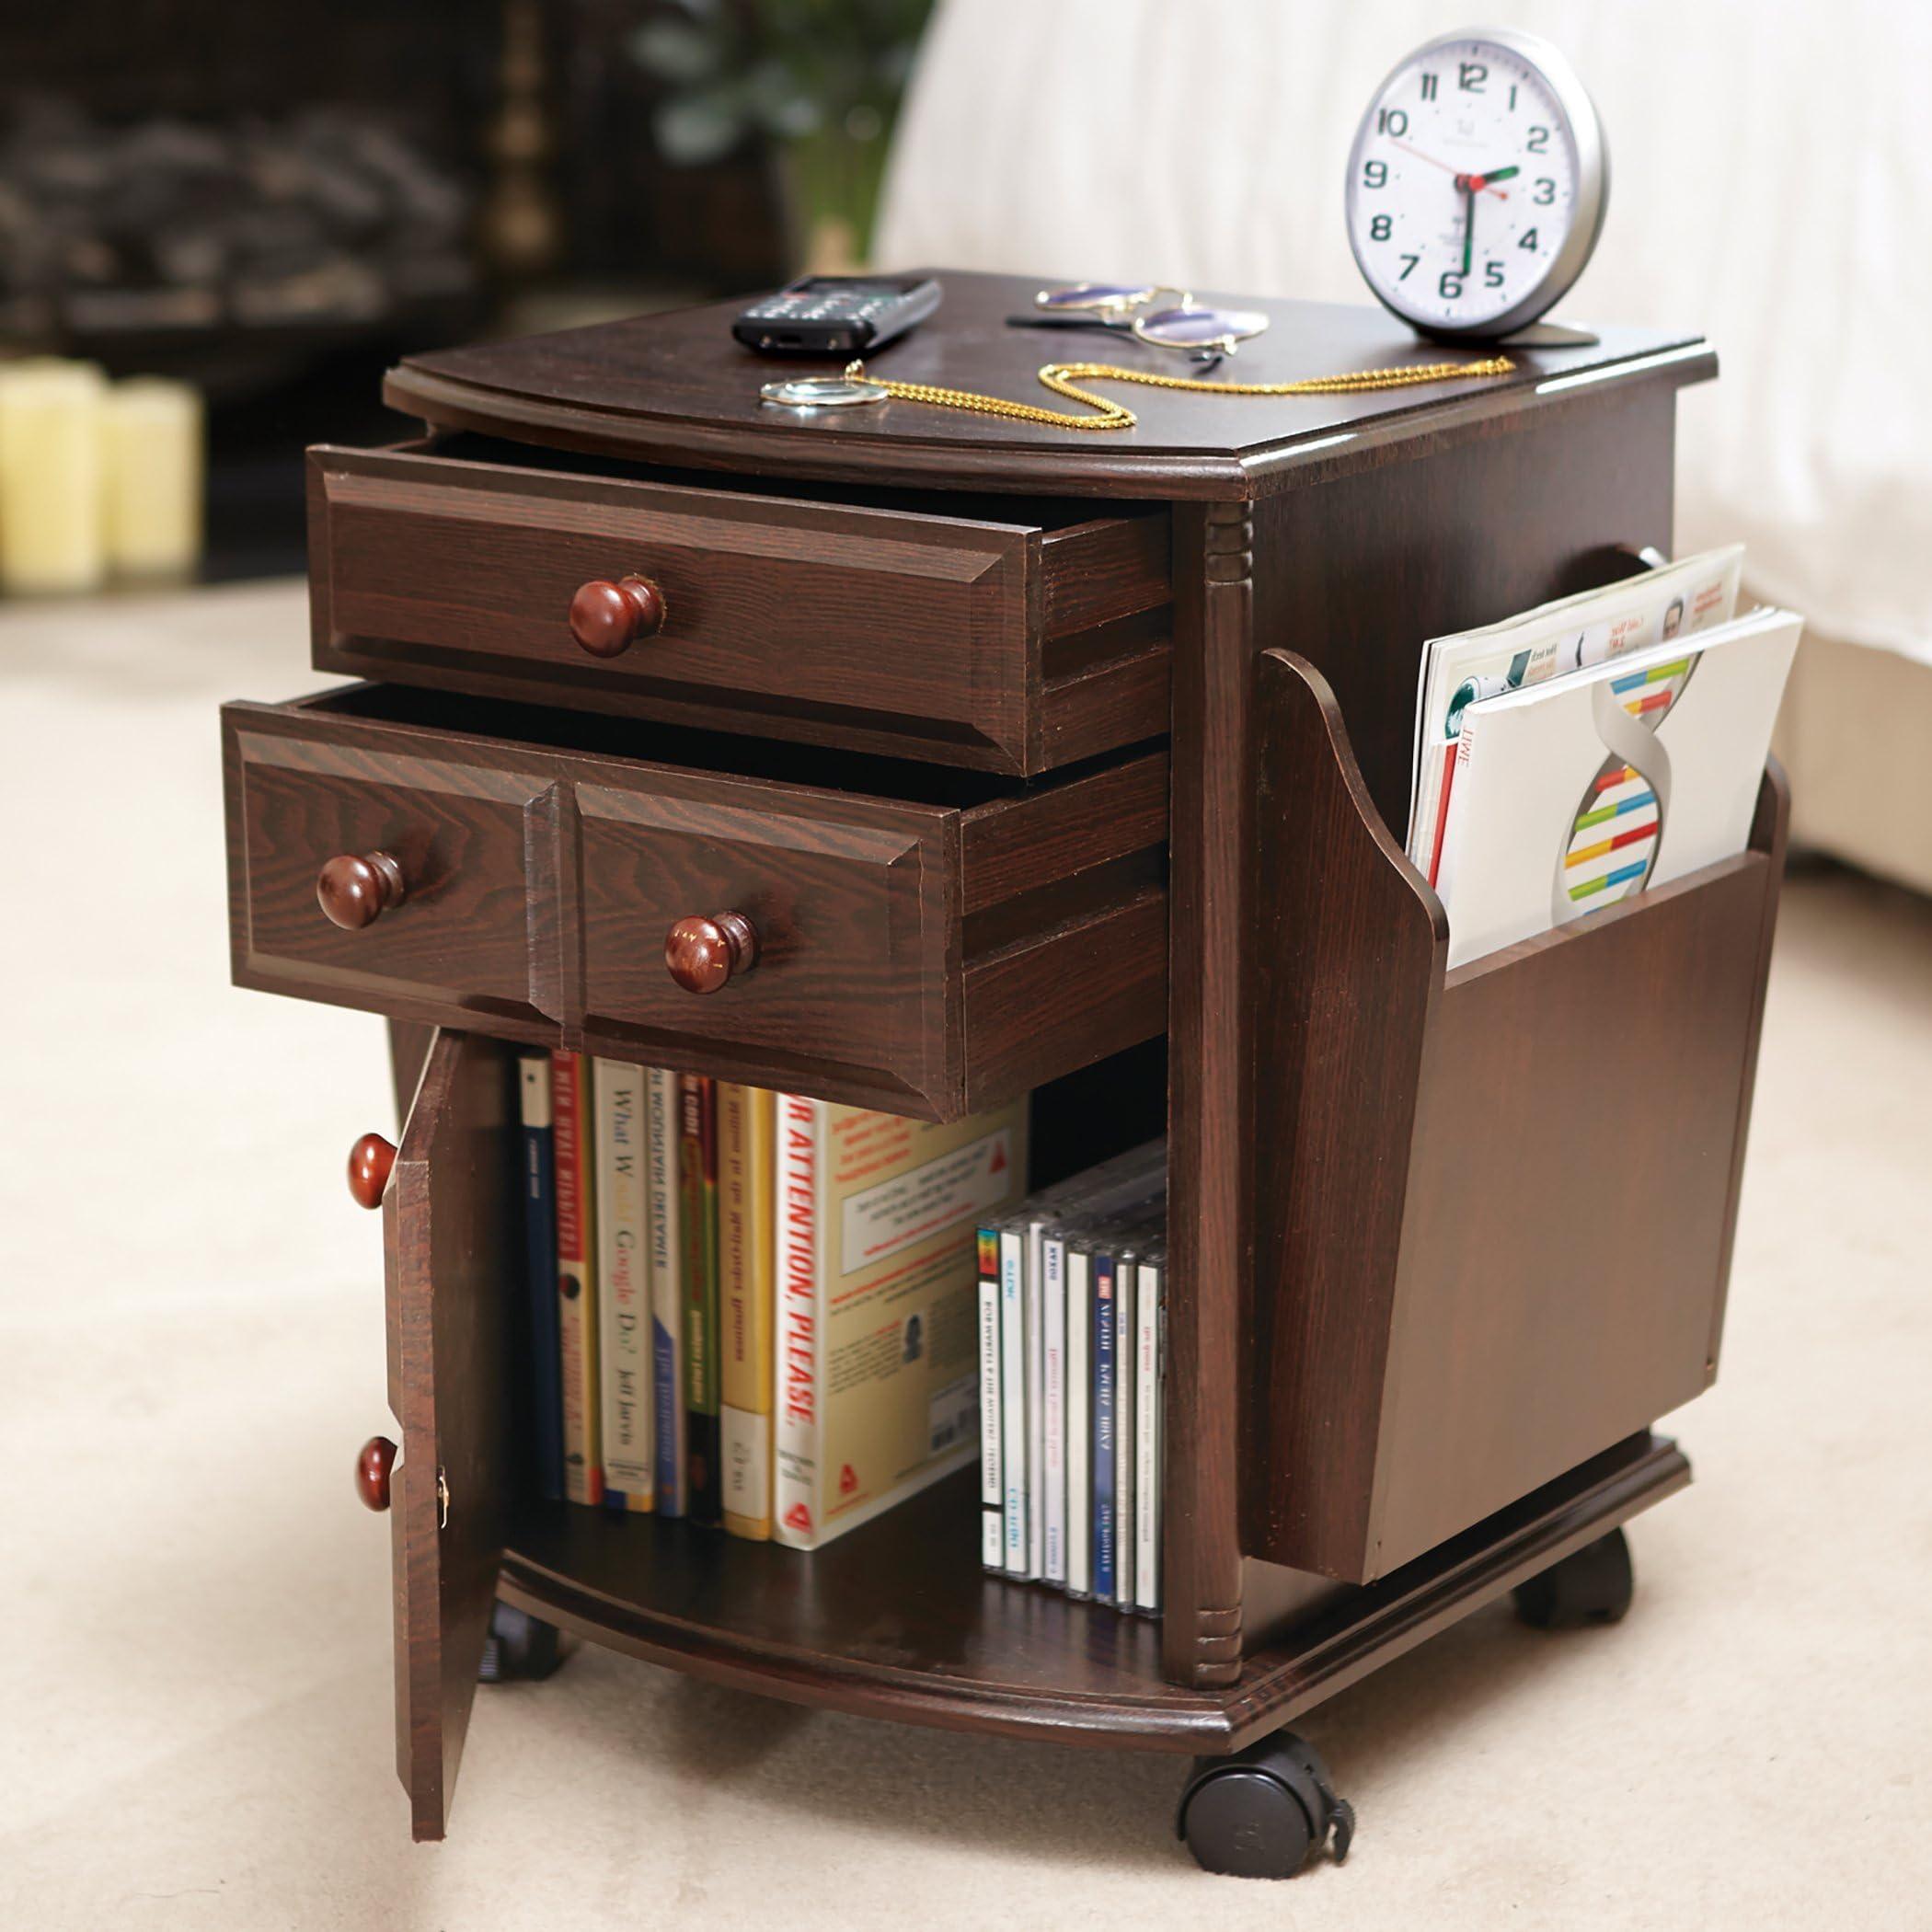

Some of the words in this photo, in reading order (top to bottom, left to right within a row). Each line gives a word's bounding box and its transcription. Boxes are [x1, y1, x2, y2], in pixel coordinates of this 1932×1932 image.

[1421, 74, 1438, 101] 11
[1458, 62, 1488, 93] 12
[1509, 85, 1517, 112] 1
[1377, 108, 1409, 137] 10
[1526, 126, 1549, 155] 2
[1363, 160, 1387, 189] 9
[1533, 178, 1556, 205] 3
[1370, 214, 1392, 241] 8
[1518, 227, 1538, 253] 4
[1398, 254, 1420, 282] 7
[1484, 261, 1505, 288] 5
[1438, 270, 1463, 299] 6
[614, 1088, 635, 1145] What
[785, 1129, 817, 1300] ATTENTION,
[611, 1229, 637, 1305] Google
[617, 1313, 637, 1354] Do?
[618, 1368, 635, 1397] Jeff
[617, 1399, 635, 1446] Jarvis
